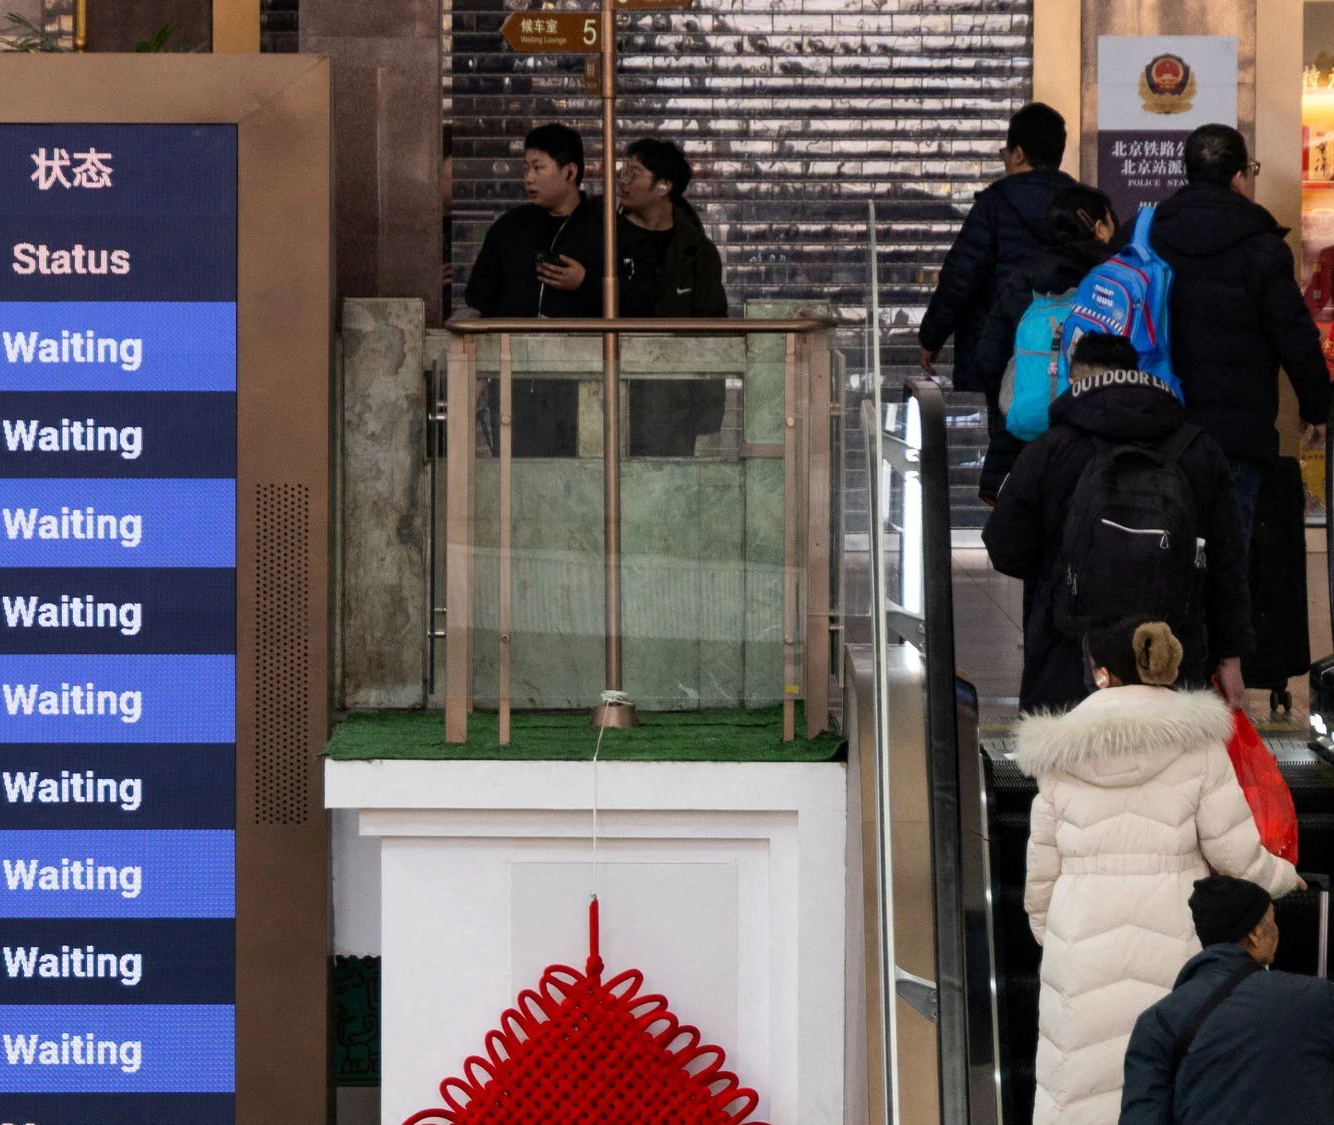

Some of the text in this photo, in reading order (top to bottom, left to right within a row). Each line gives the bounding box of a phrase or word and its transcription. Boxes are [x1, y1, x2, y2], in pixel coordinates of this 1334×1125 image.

[521, 18, 558, 34] 候车室
[544, 36, 567, 45] Lounge
[583, 19, 597, 45] 5
[32, 149, 113, 190] 状态
[1127, 178, 1161, 187] POLICE
[14, 244, 130, 275] Status
[4, 332, 143, 372] Waiting
[1071, 368, 1149, 397] OUTDOOR
[4, 420, 142, 460] Waiting
[4, 508, 142, 548] Waiting
[4, 596, 142, 636] Waiting
[4, 684, 142, 724] Waiting
[4, 772, 142, 811] Waiting
[4, 859, 142, 899] Waiting
[5, 947, 142, 986] Waiting
[4, 1034, 142, 1073] Waiting
